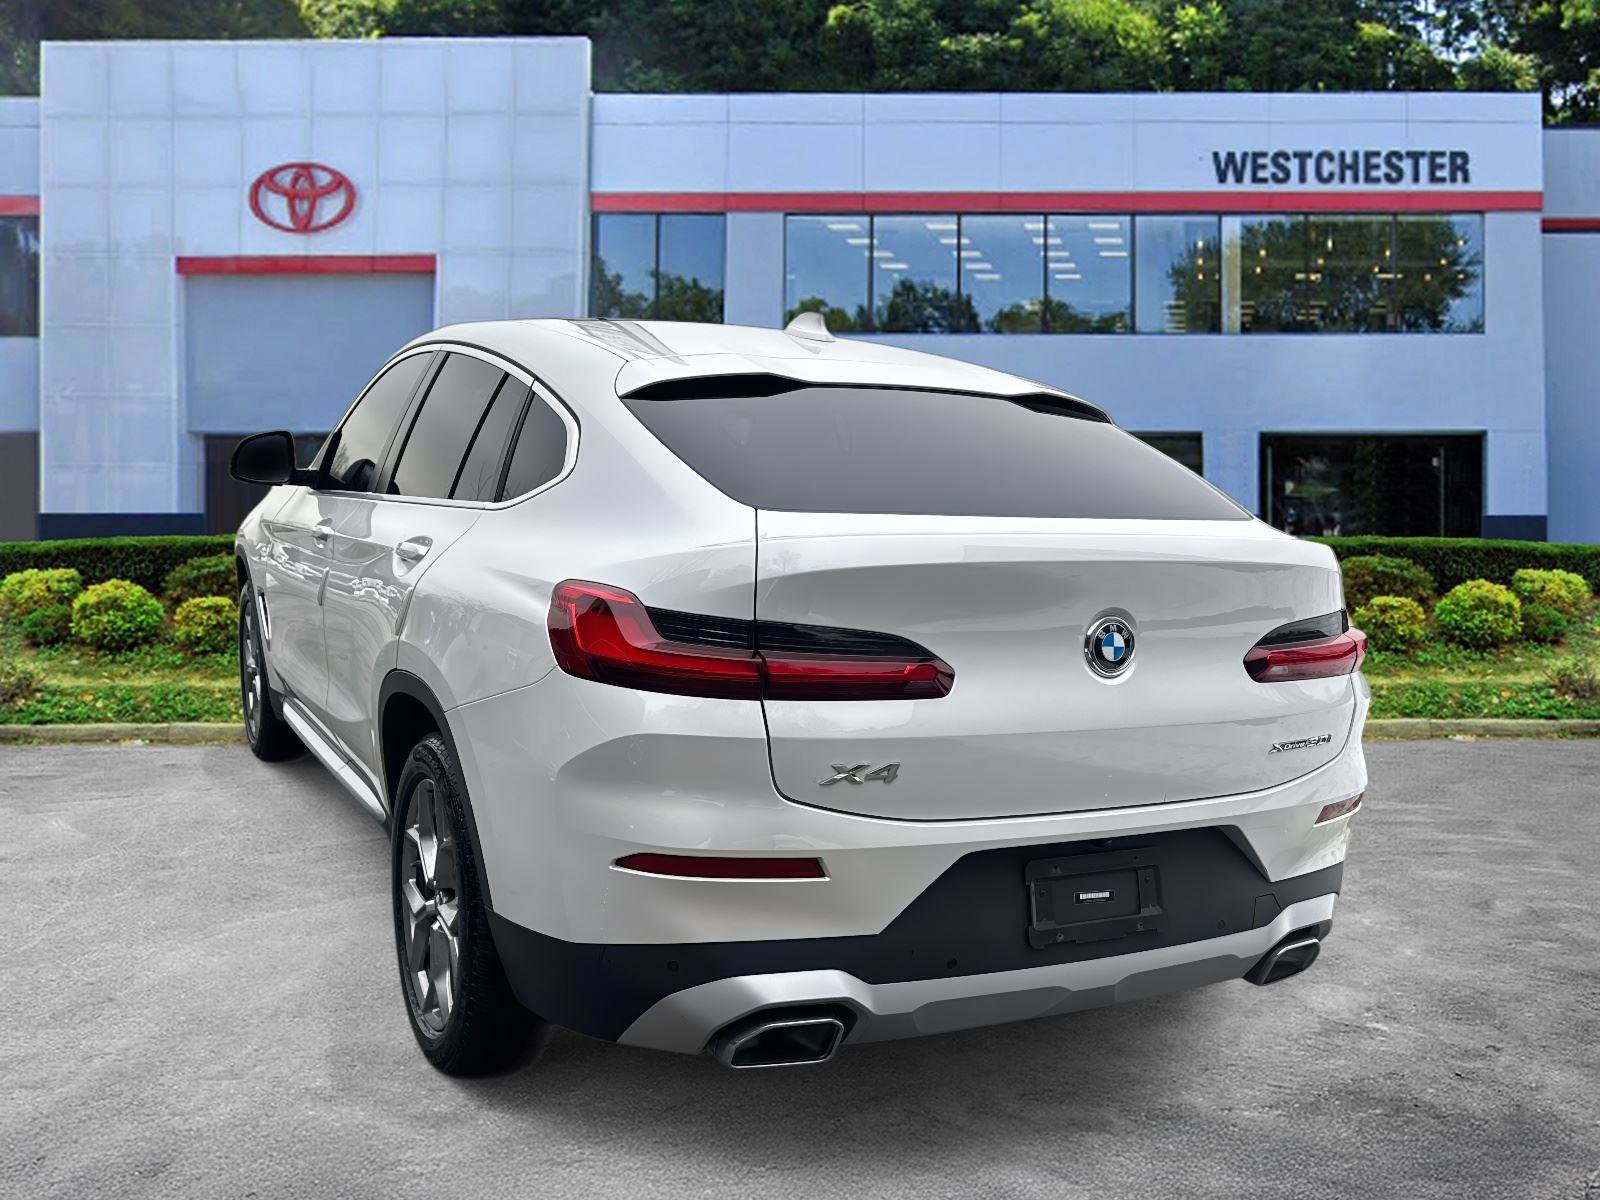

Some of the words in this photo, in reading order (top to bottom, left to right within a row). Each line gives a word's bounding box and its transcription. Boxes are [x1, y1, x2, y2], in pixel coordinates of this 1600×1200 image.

[1212, 150, 1471, 184] WESTCHESTER
[1097, 624, 1130, 640] BMW
[818, 762, 901, 786] X4
